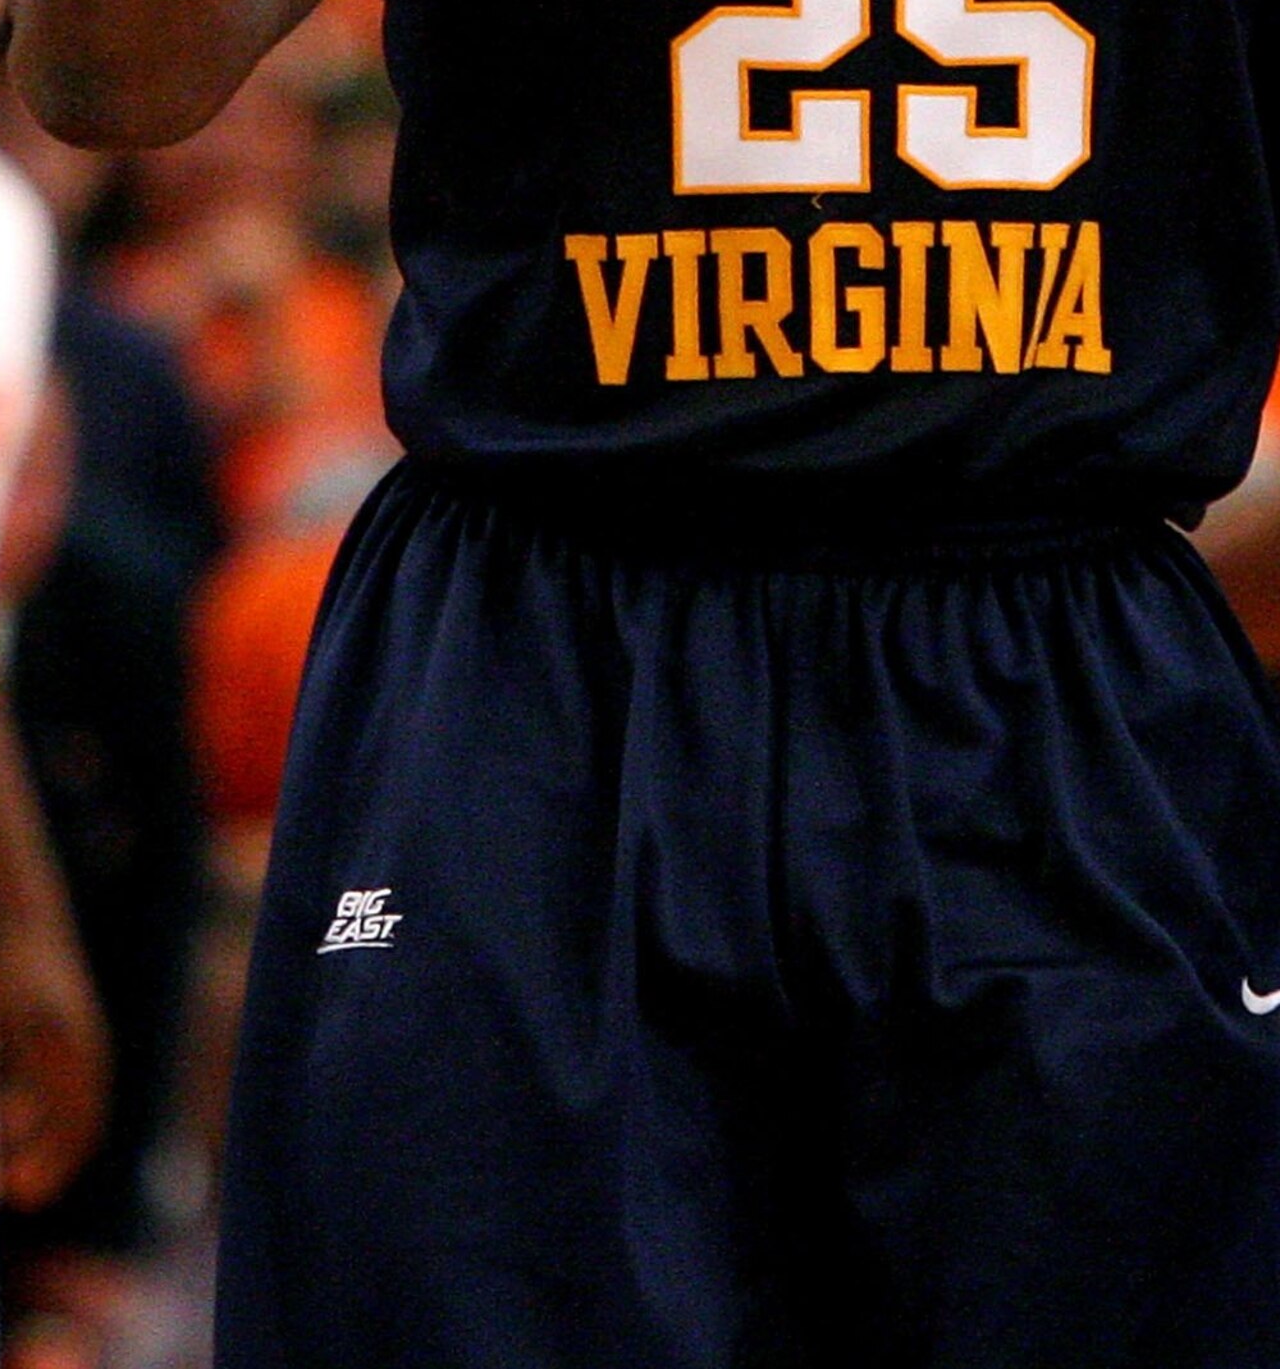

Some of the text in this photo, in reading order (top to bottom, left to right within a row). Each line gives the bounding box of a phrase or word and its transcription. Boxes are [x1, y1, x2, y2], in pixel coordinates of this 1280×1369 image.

[563, 220, 1114, 387] VIRGINIA
[336, 888, 392, 918] BIG
[323, 914, 404, 943] EAST
